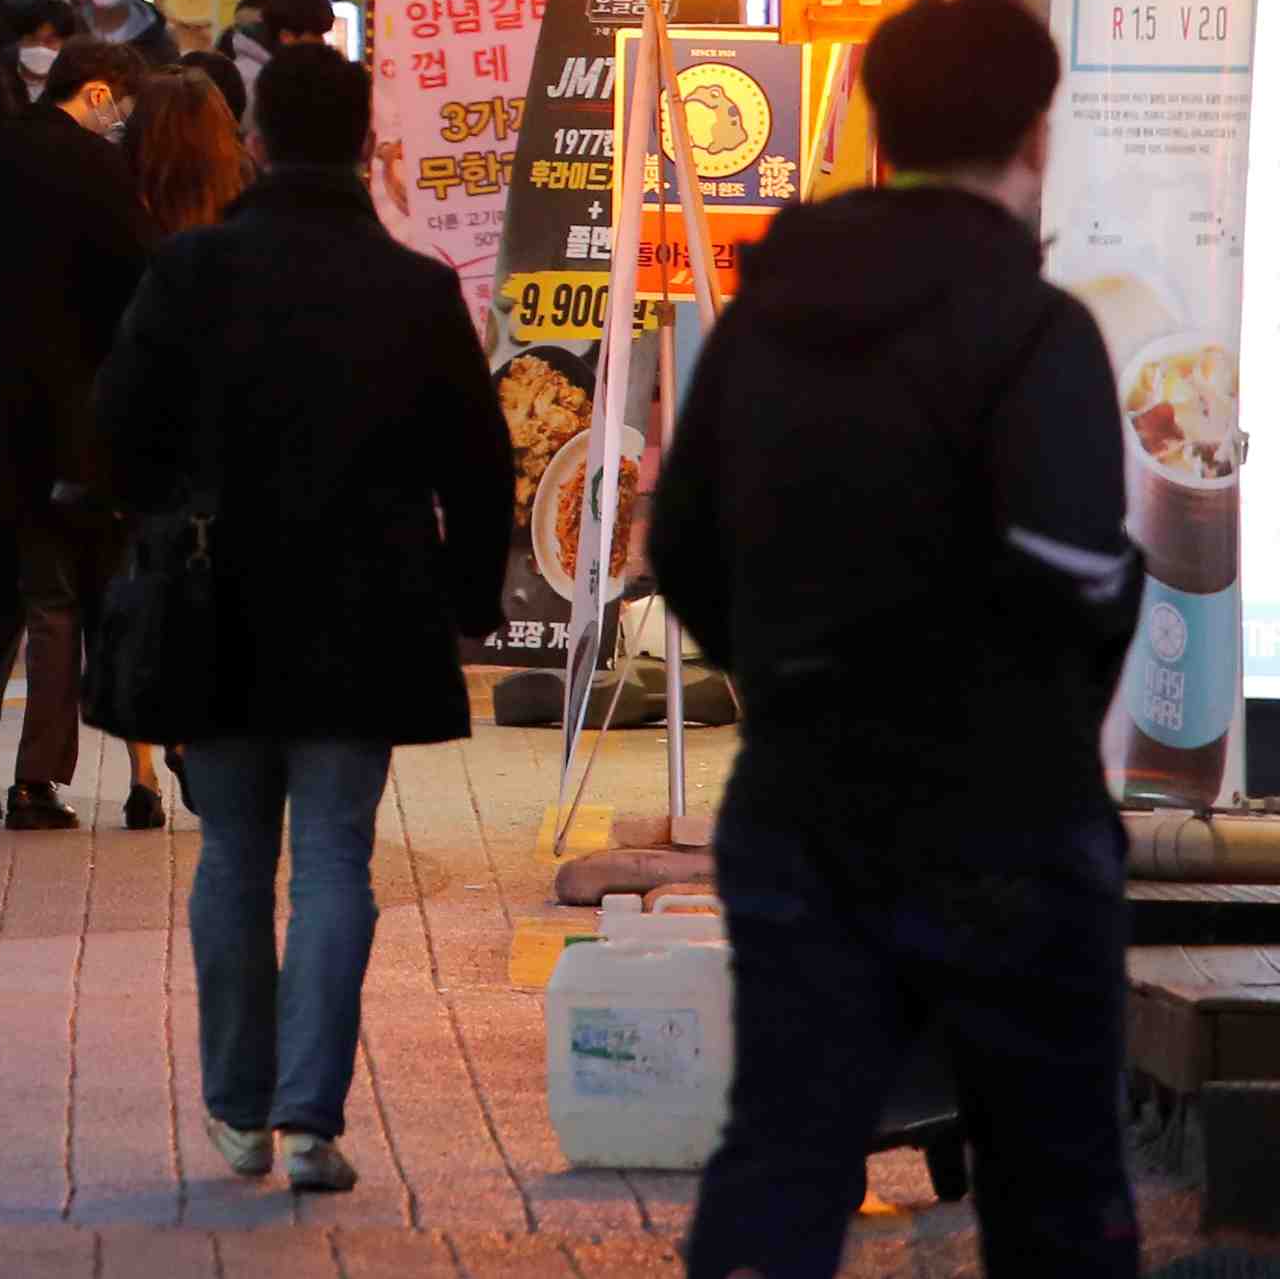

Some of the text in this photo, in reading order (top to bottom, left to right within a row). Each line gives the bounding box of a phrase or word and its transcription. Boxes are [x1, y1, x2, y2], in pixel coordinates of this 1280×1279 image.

[1112, 6, 1228, 41] R 1.5 V 2.0
